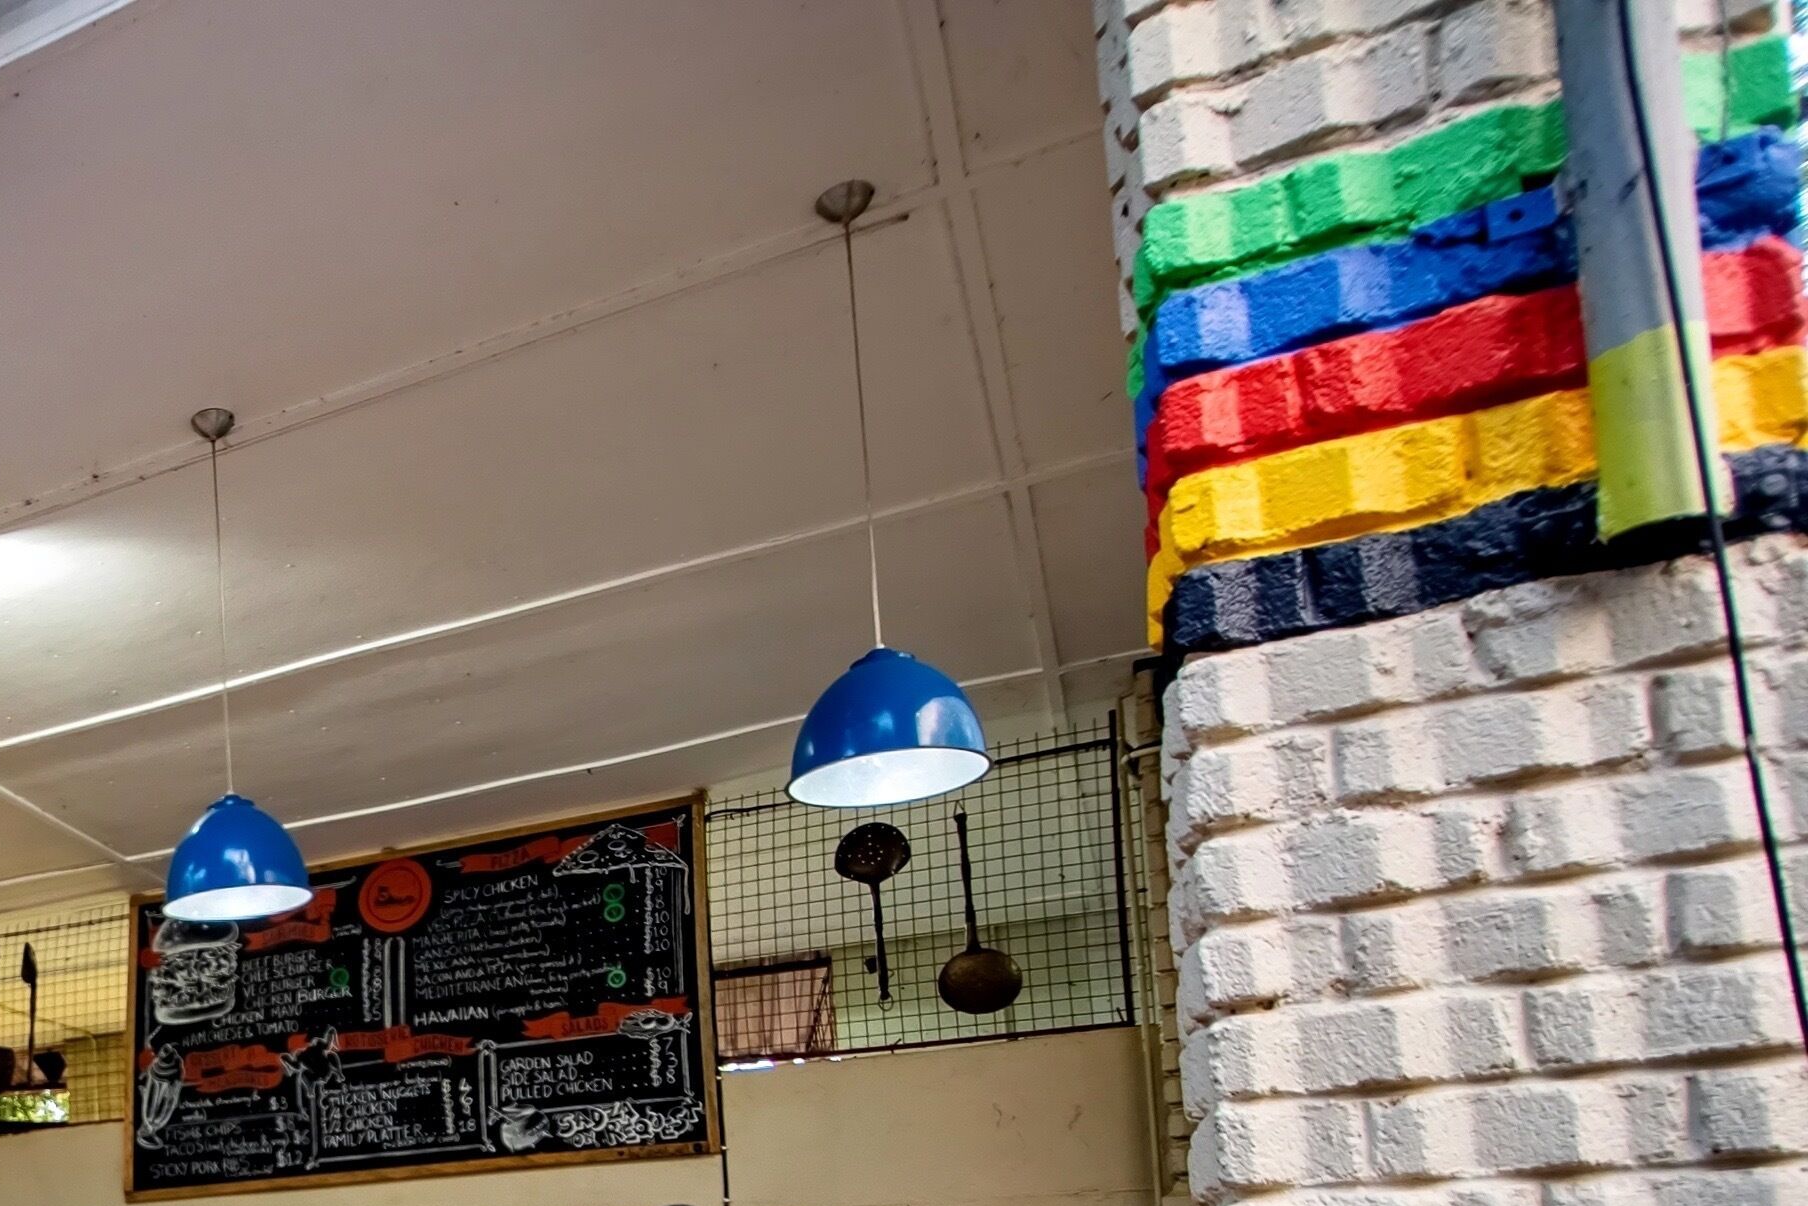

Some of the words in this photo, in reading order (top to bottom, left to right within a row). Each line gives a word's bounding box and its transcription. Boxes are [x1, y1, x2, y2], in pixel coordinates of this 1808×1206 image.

[444, 886, 481, 903] SPICY
[482, 874, 538, 897] CHICKEN
[272, 948, 317, 967] BURGER
[243, 982, 267, 998] VEG
[271, 975, 315, 993] BURGER
[415, 972, 453, 987] BACON
[243, 991, 292, 1010] CHICKEN
[296, 985, 353, 1004] BURGER
[212, 1009, 264, 1028] CHICKEN
[272, 1004, 302, 1019] MAYO
[413, 1006, 489, 1027] HAWAIIAN
[256, 1020, 299, 1036] TOMATO
[500, 1056, 552, 1072] GARDEN
[556, 1051, 594, 1066] SALAD
[501, 1071, 530, 1087] SIDE
[534, 1067, 578, 1084] SALAD
[320, 1089, 377, 1111] CHICKEN
[382, 1083, 432, 1100] NUGGETS
[500, 1084, 552, 1102] PULLED
[556, 1077, 613, 1096] CHICKEN
[344, 1100, 398, 1118] CHICKEN
[345, 1115, 394, 1132] CHICKEN
[322, 1133, 367, 1149] FAMILY
[367, 1123, 423, 1144] PLATTER
[164, 1141, 204, 1158] TACOS
[149, 1162, 189, 1179] STICKY
[192, 1161, 221, 1175] PORK
